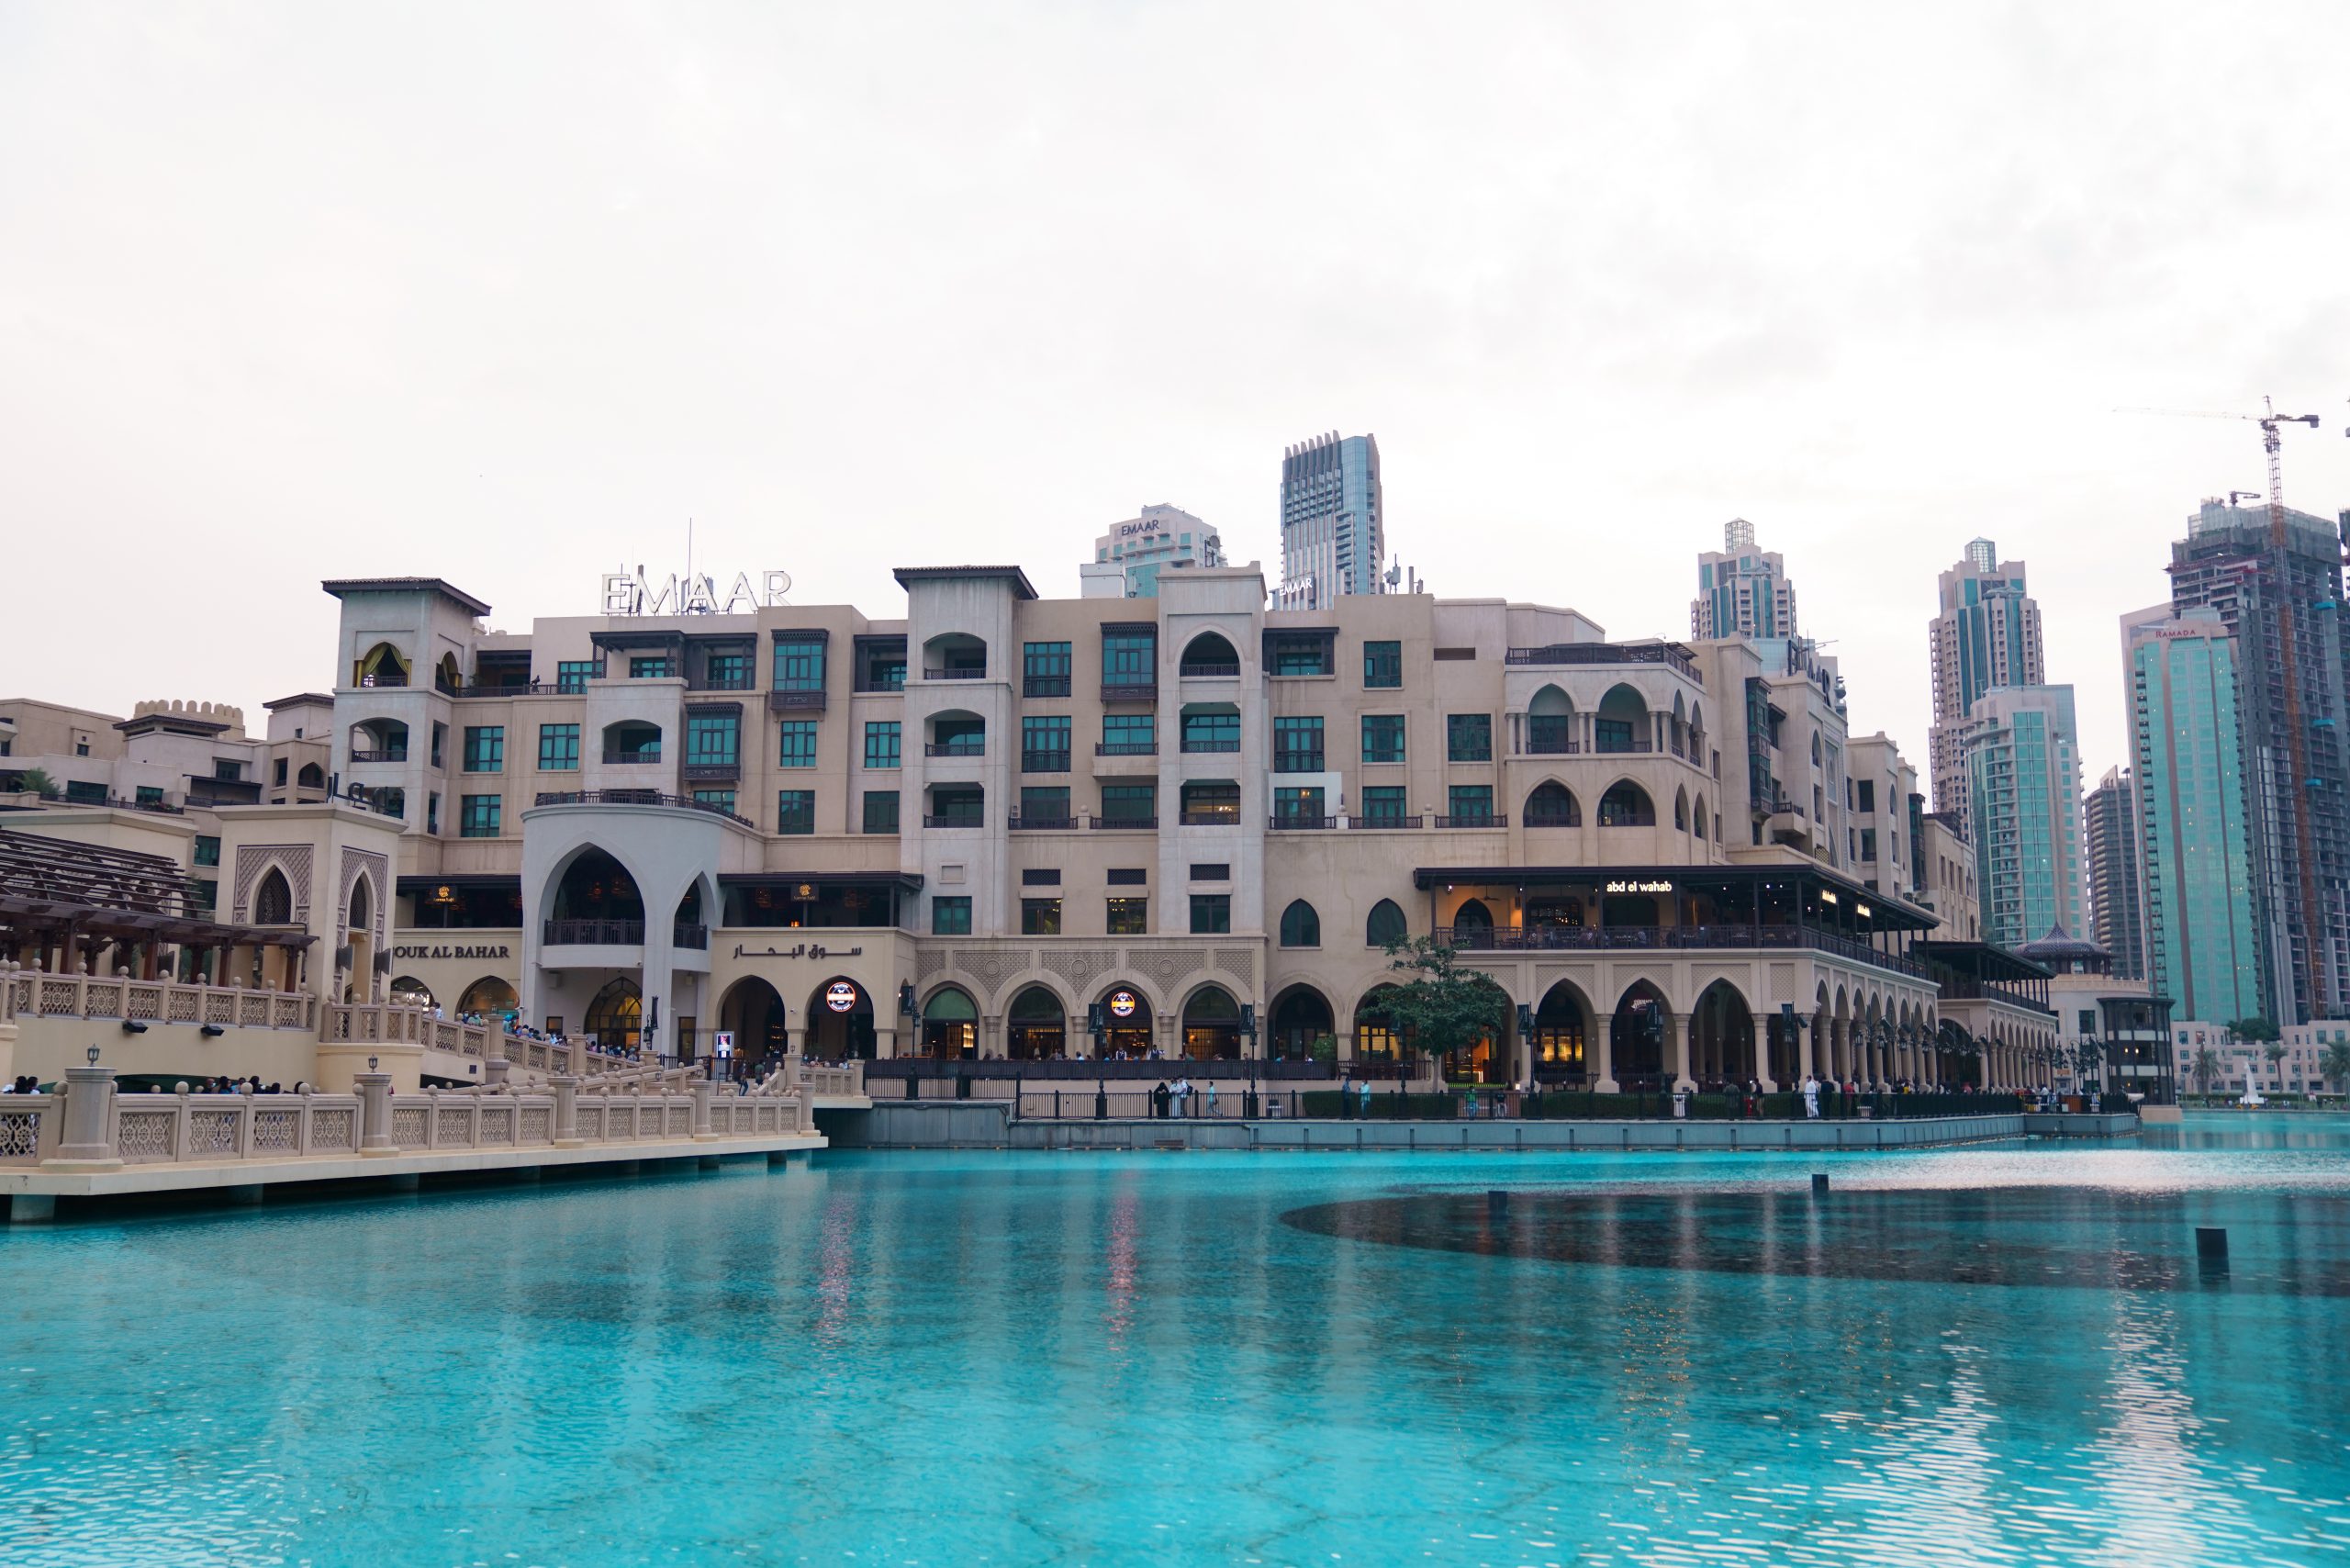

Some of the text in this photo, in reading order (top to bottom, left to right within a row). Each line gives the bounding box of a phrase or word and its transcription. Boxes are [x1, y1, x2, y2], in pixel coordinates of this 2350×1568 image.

[1122, 520, 1159, 536] EMAAR
[600, 570, 792, 614] EMAAR
[1280, 577, 1313, 596] EMAAR
[2155, 629, 2196, 639] RAMADA
[1606, 881, 1673, 892] abd el wahab
[393, 946, 510, 958] OUK AL BAHAR
[733, 944, 862, 959] سوق البحار
